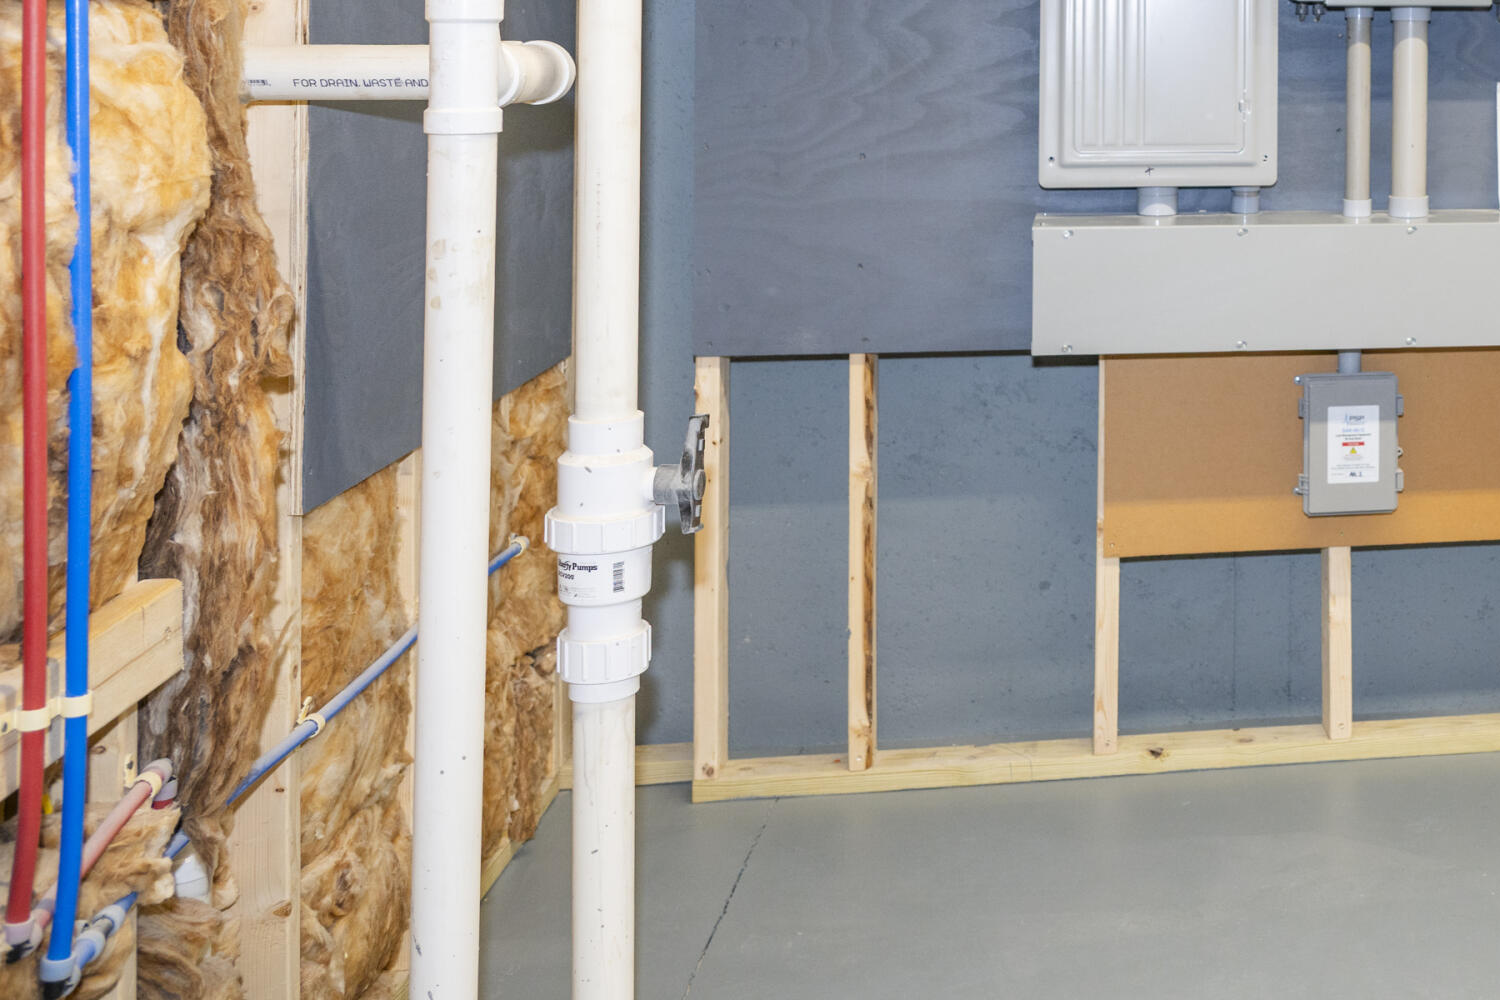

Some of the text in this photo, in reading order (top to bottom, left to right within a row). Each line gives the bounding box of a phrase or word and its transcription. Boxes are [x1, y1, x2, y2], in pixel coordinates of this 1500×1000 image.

[292, 78, 317, 88] FOR
[363, 77, 401, 88] WASTE
[404, 78, 429, 88] AND
[572, 562, 598, 573] Pumps
